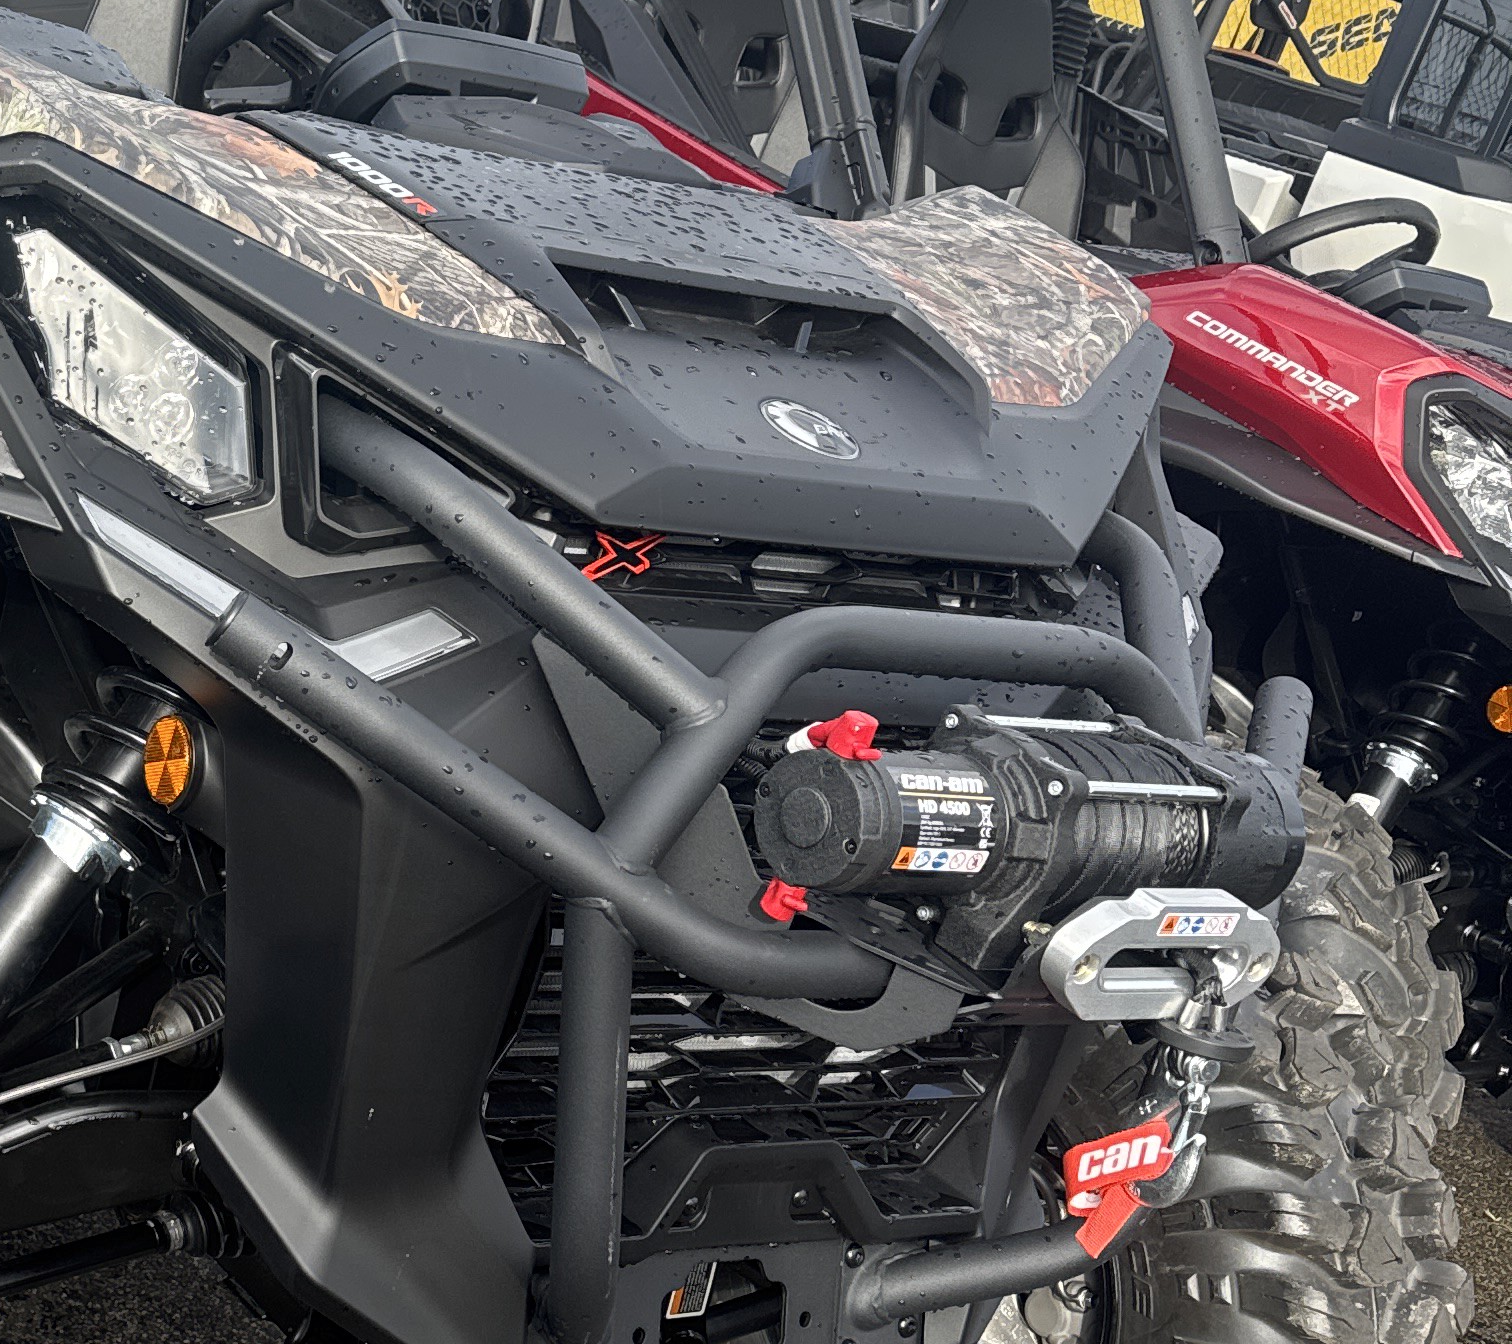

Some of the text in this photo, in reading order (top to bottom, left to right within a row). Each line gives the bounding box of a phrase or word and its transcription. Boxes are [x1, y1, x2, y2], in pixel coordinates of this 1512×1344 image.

[327, 151, 439, 216] 1000R
[1185, 310, 1361, 408] COMMANDER
[1300, 389, 1347, 414] XT
[900, 773, 984, 794] can-am
[917, 798, 971, 816] HD 4500
